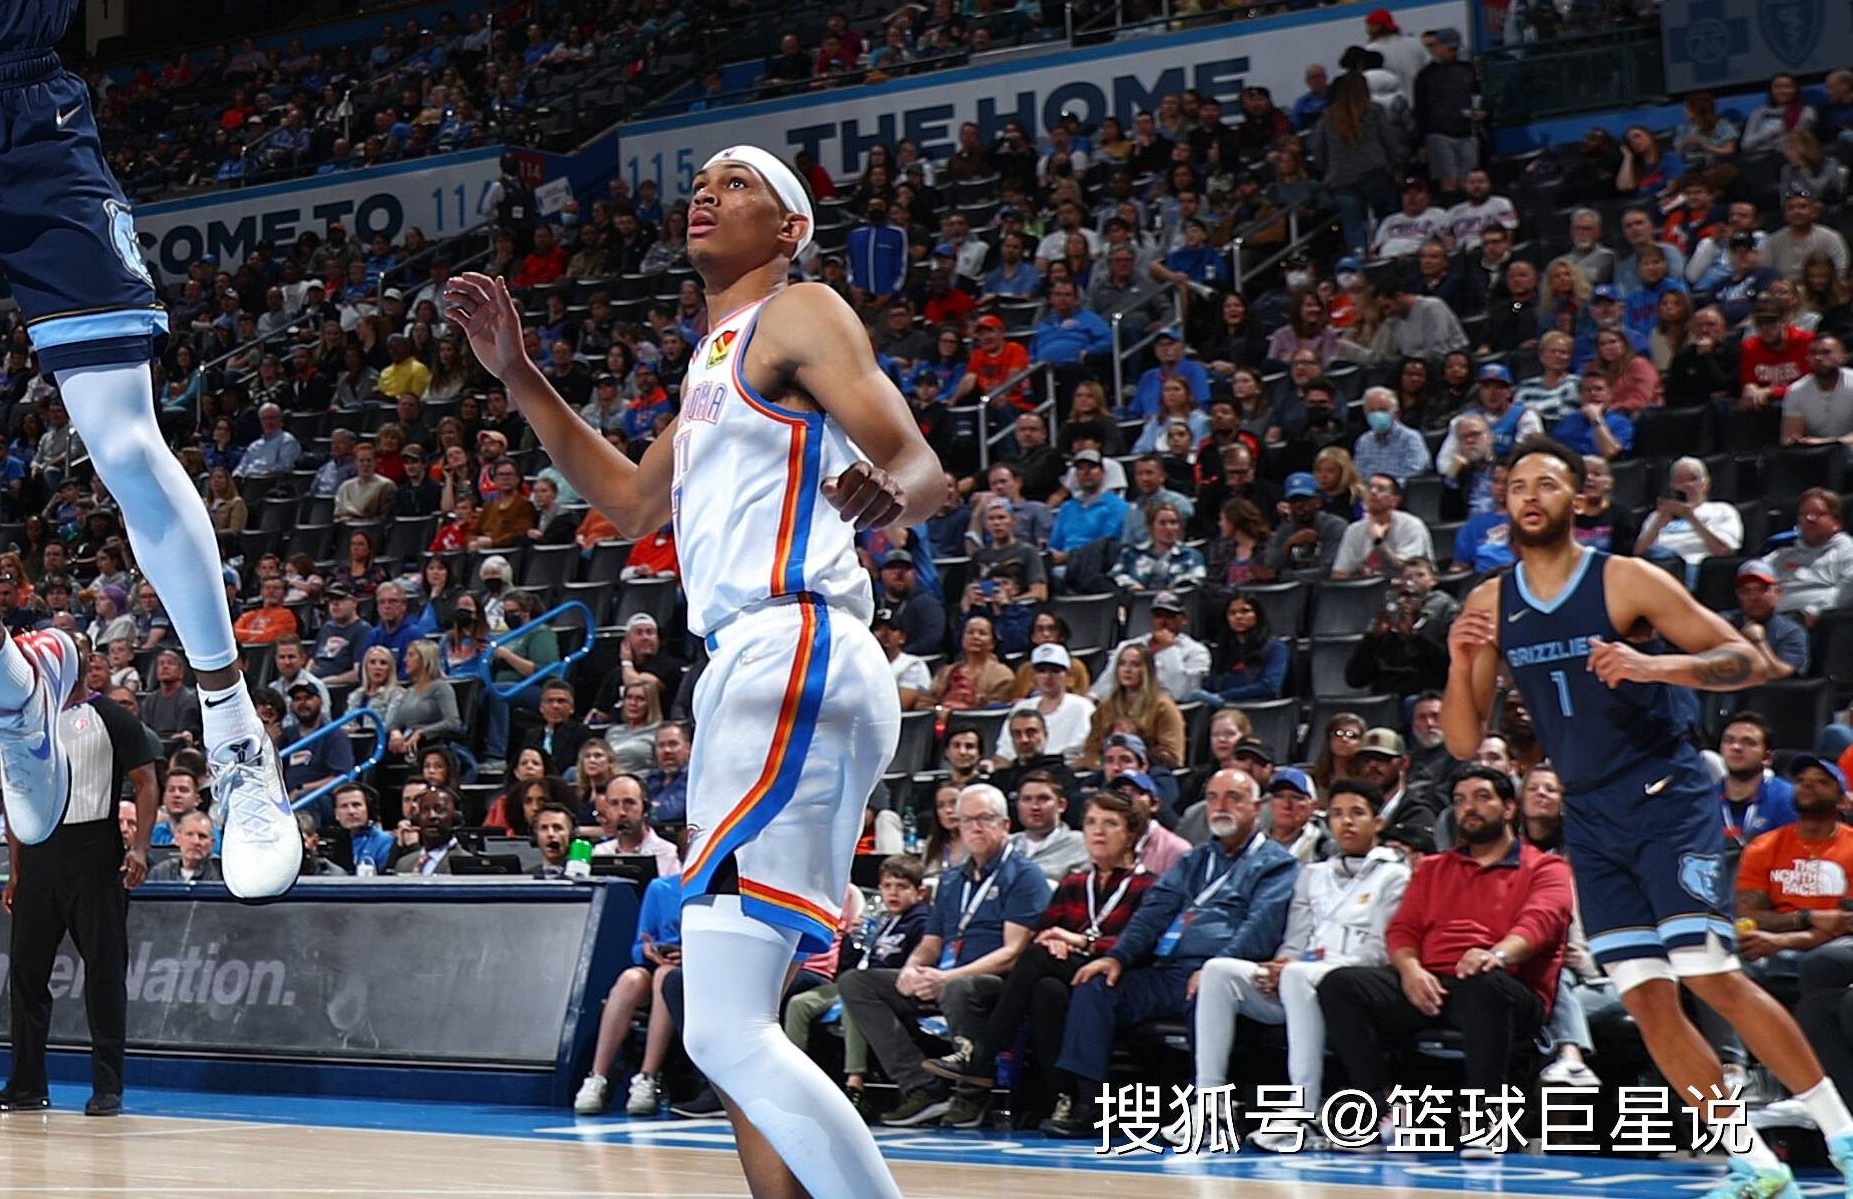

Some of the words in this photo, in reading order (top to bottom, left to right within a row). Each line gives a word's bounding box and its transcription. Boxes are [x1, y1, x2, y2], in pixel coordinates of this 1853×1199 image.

[787, 105, 954, 173] THE
[979, 57, 1252, 147] HOME
[629, 148, 693, 196] 115
[314, 193, 404, 246] TO
[1550, 670, 1573, 717] 1
